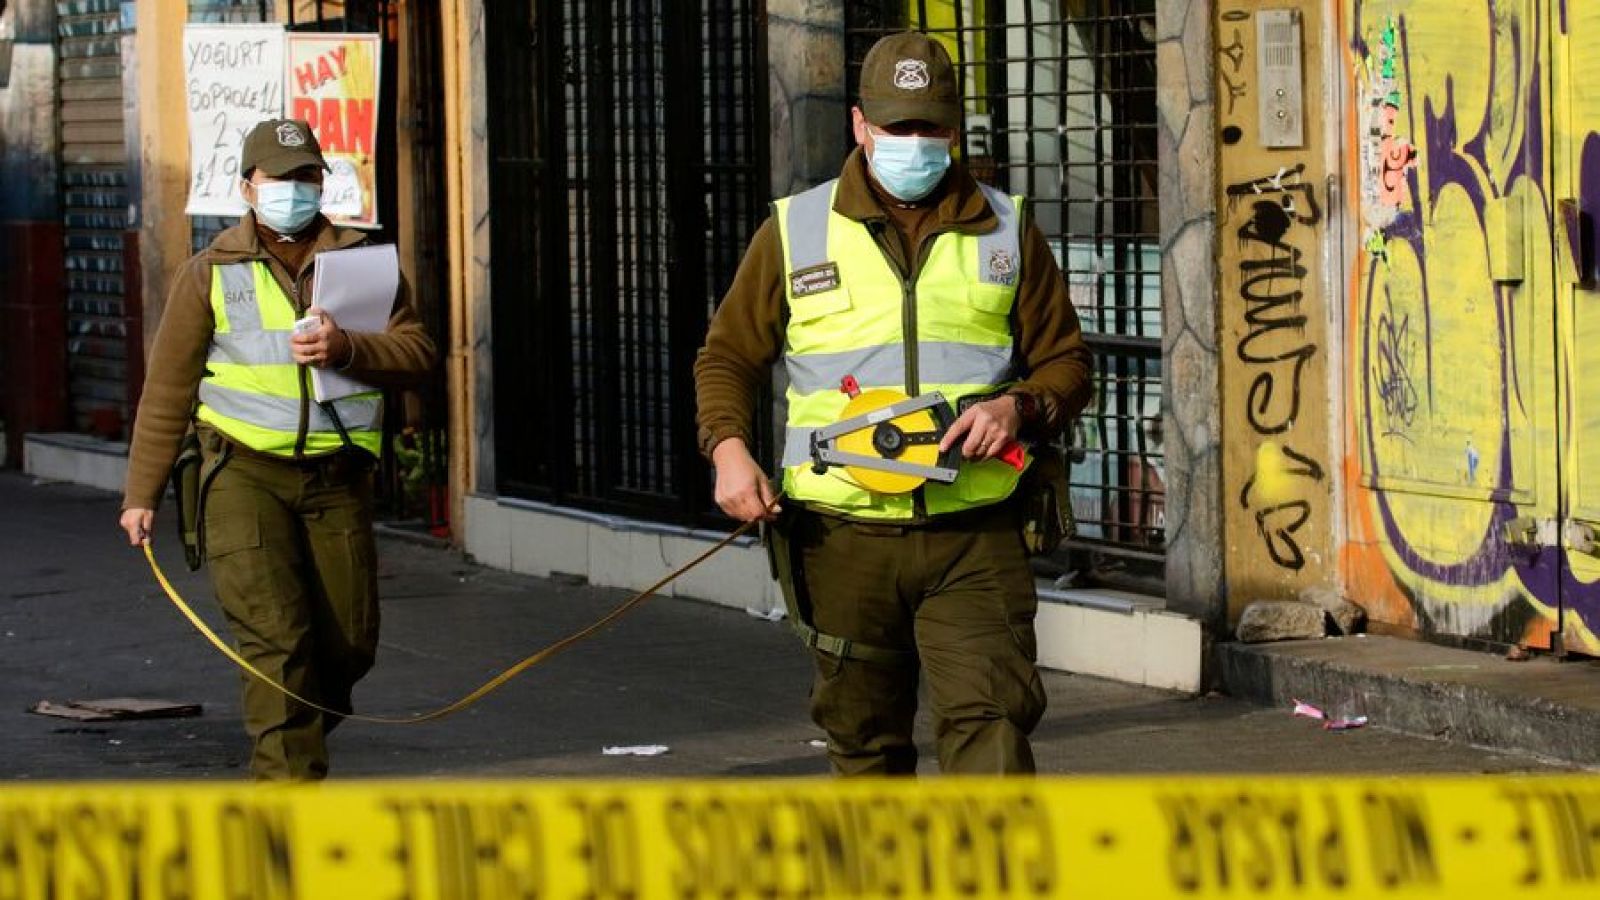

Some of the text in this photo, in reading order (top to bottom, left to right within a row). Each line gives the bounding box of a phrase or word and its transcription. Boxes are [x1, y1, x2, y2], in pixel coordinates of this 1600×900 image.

[189, 40, 268, 72] YOGURT
[295, 46, 347, 94] HAY
[213, 111, 228, 149] 2
[294, 98, 373, 153] PAN
[225, 290, 256, 304] SIAT
[664, 790, 1055, 897] CARABINEROS
[1156, 788, 1352, 892] PASAR
[1362, 788, 1444, 889] NO
